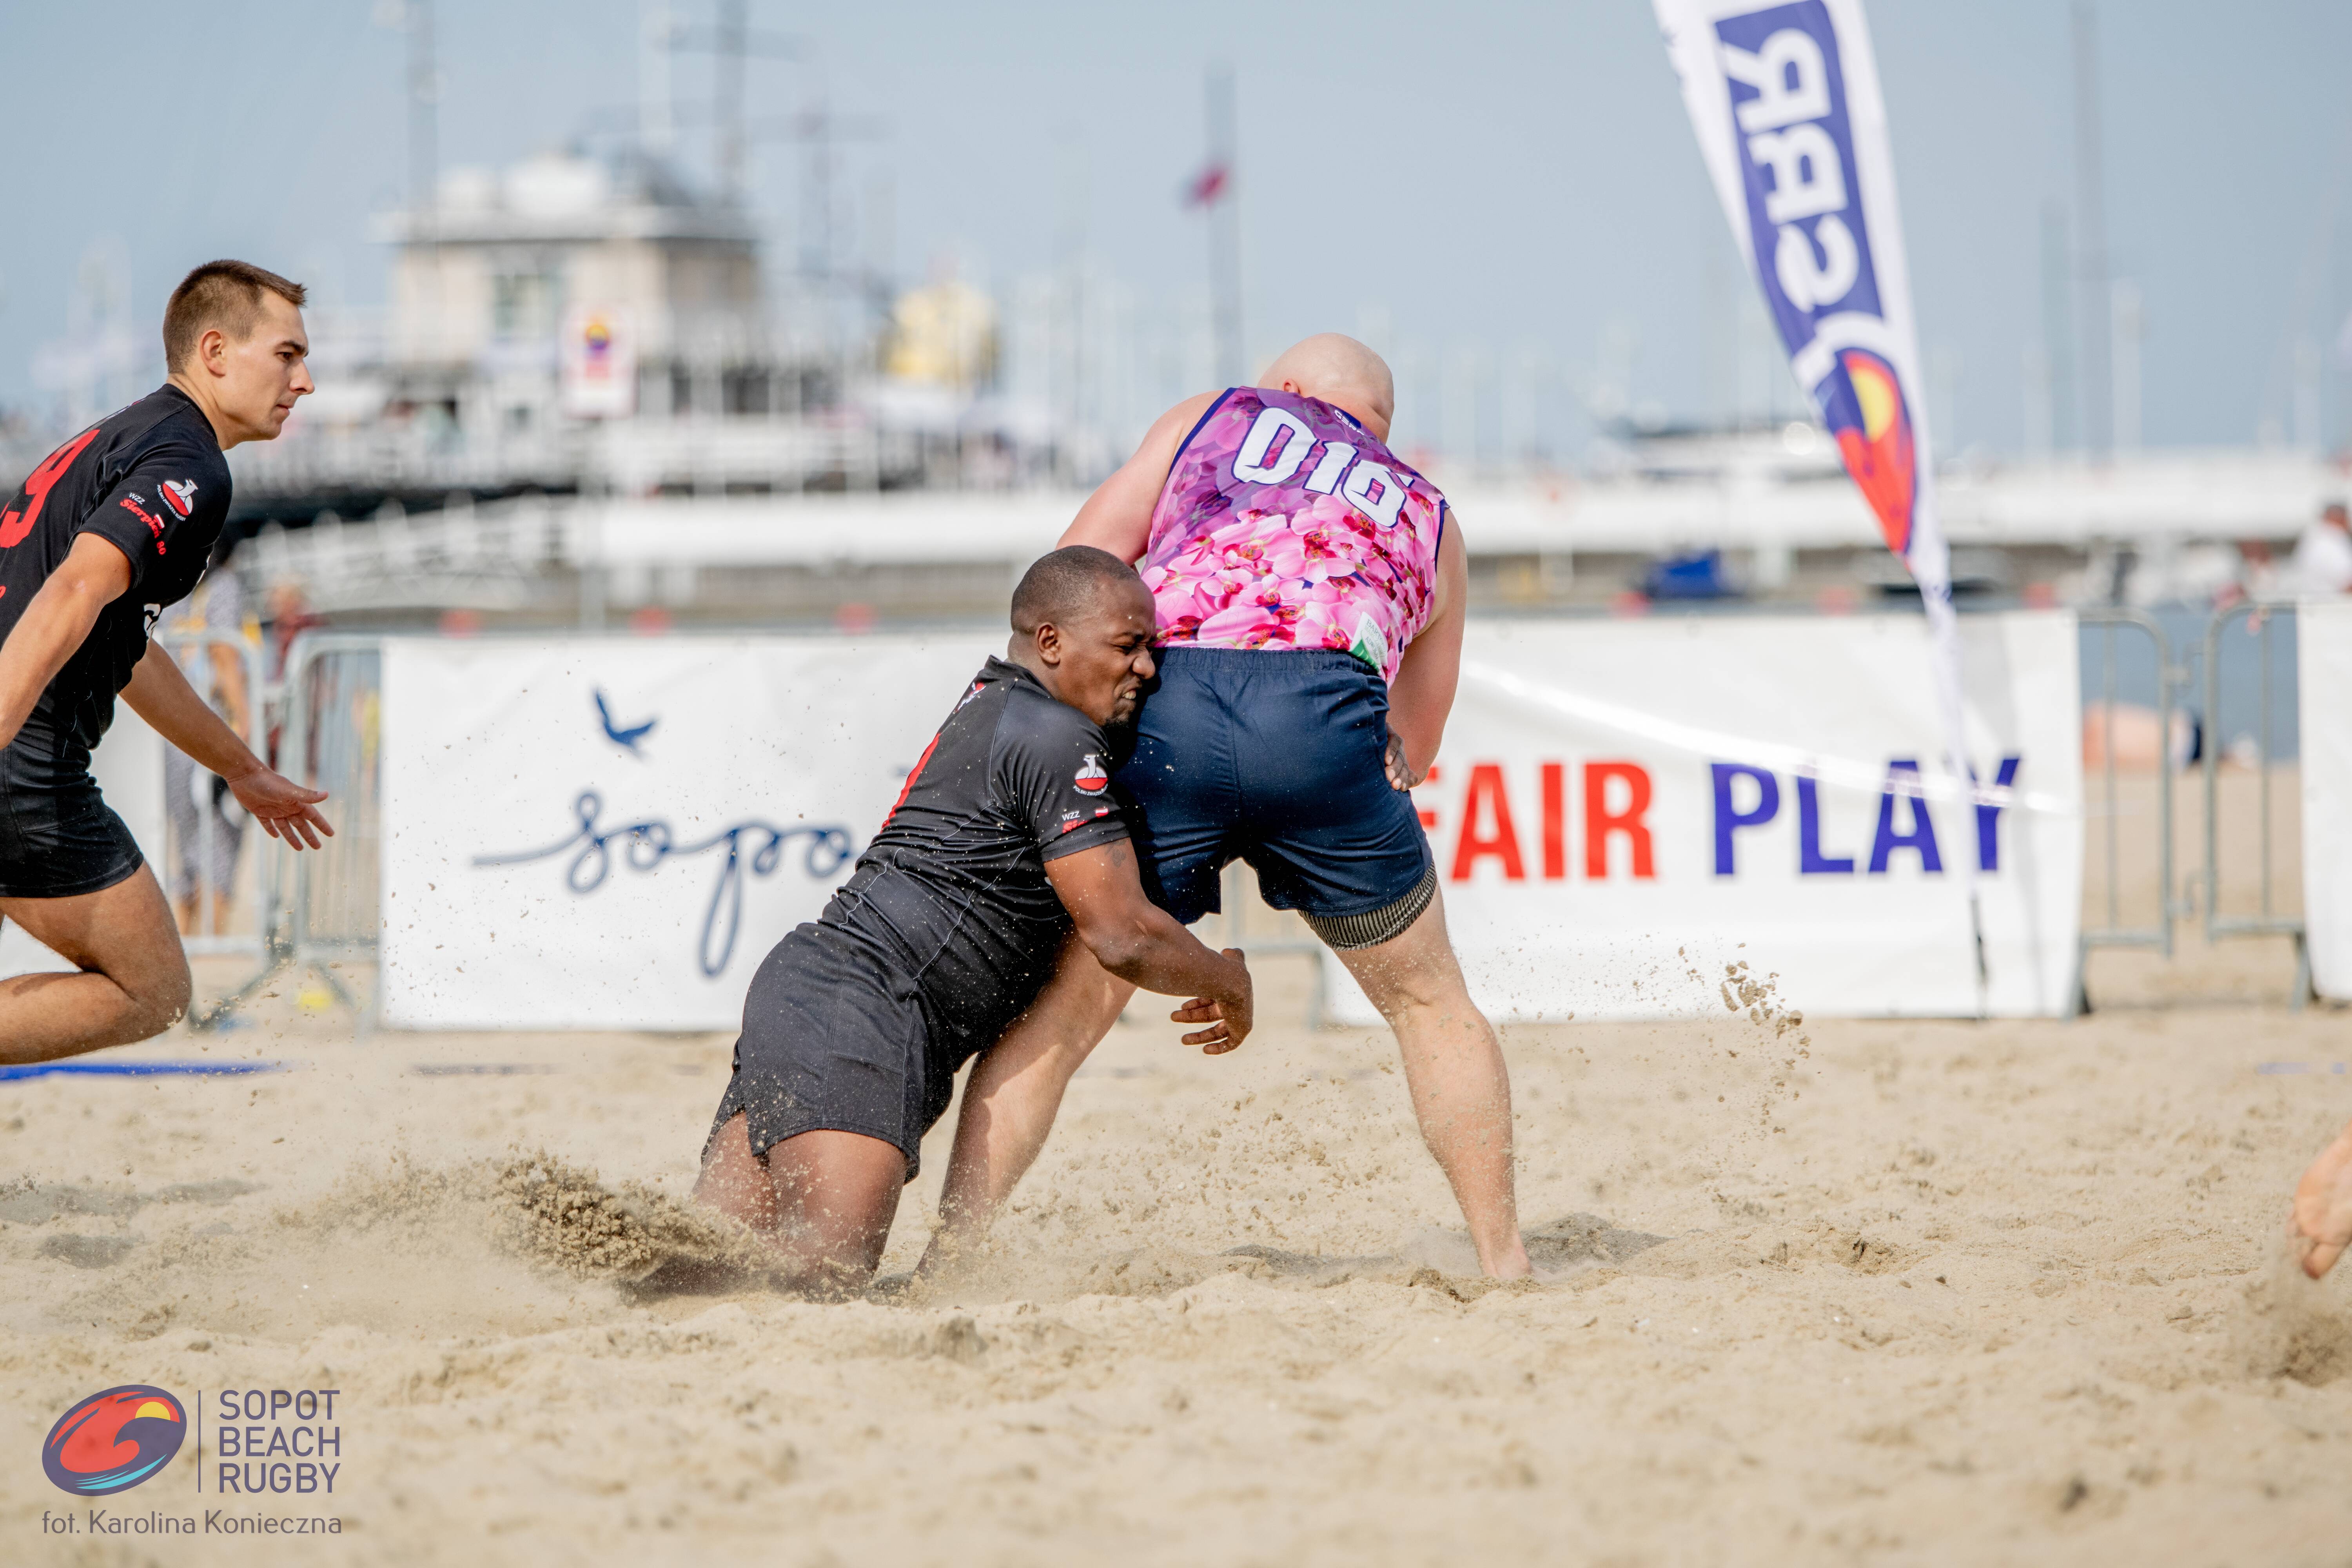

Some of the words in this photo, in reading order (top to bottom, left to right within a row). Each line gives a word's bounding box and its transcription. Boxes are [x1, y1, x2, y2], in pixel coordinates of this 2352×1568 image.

[0, 429, 100, 548] 9
[129, 492, 145, 505] WZZ
[175, 513, 186, 521] RUGBY
[157, 541, 166, 555] 80
[1073, 785, 1087, 795] POLSKI
[1062, 811, 1080, 821] WZZ
[1710, 757, 2021, 875] PLAY
